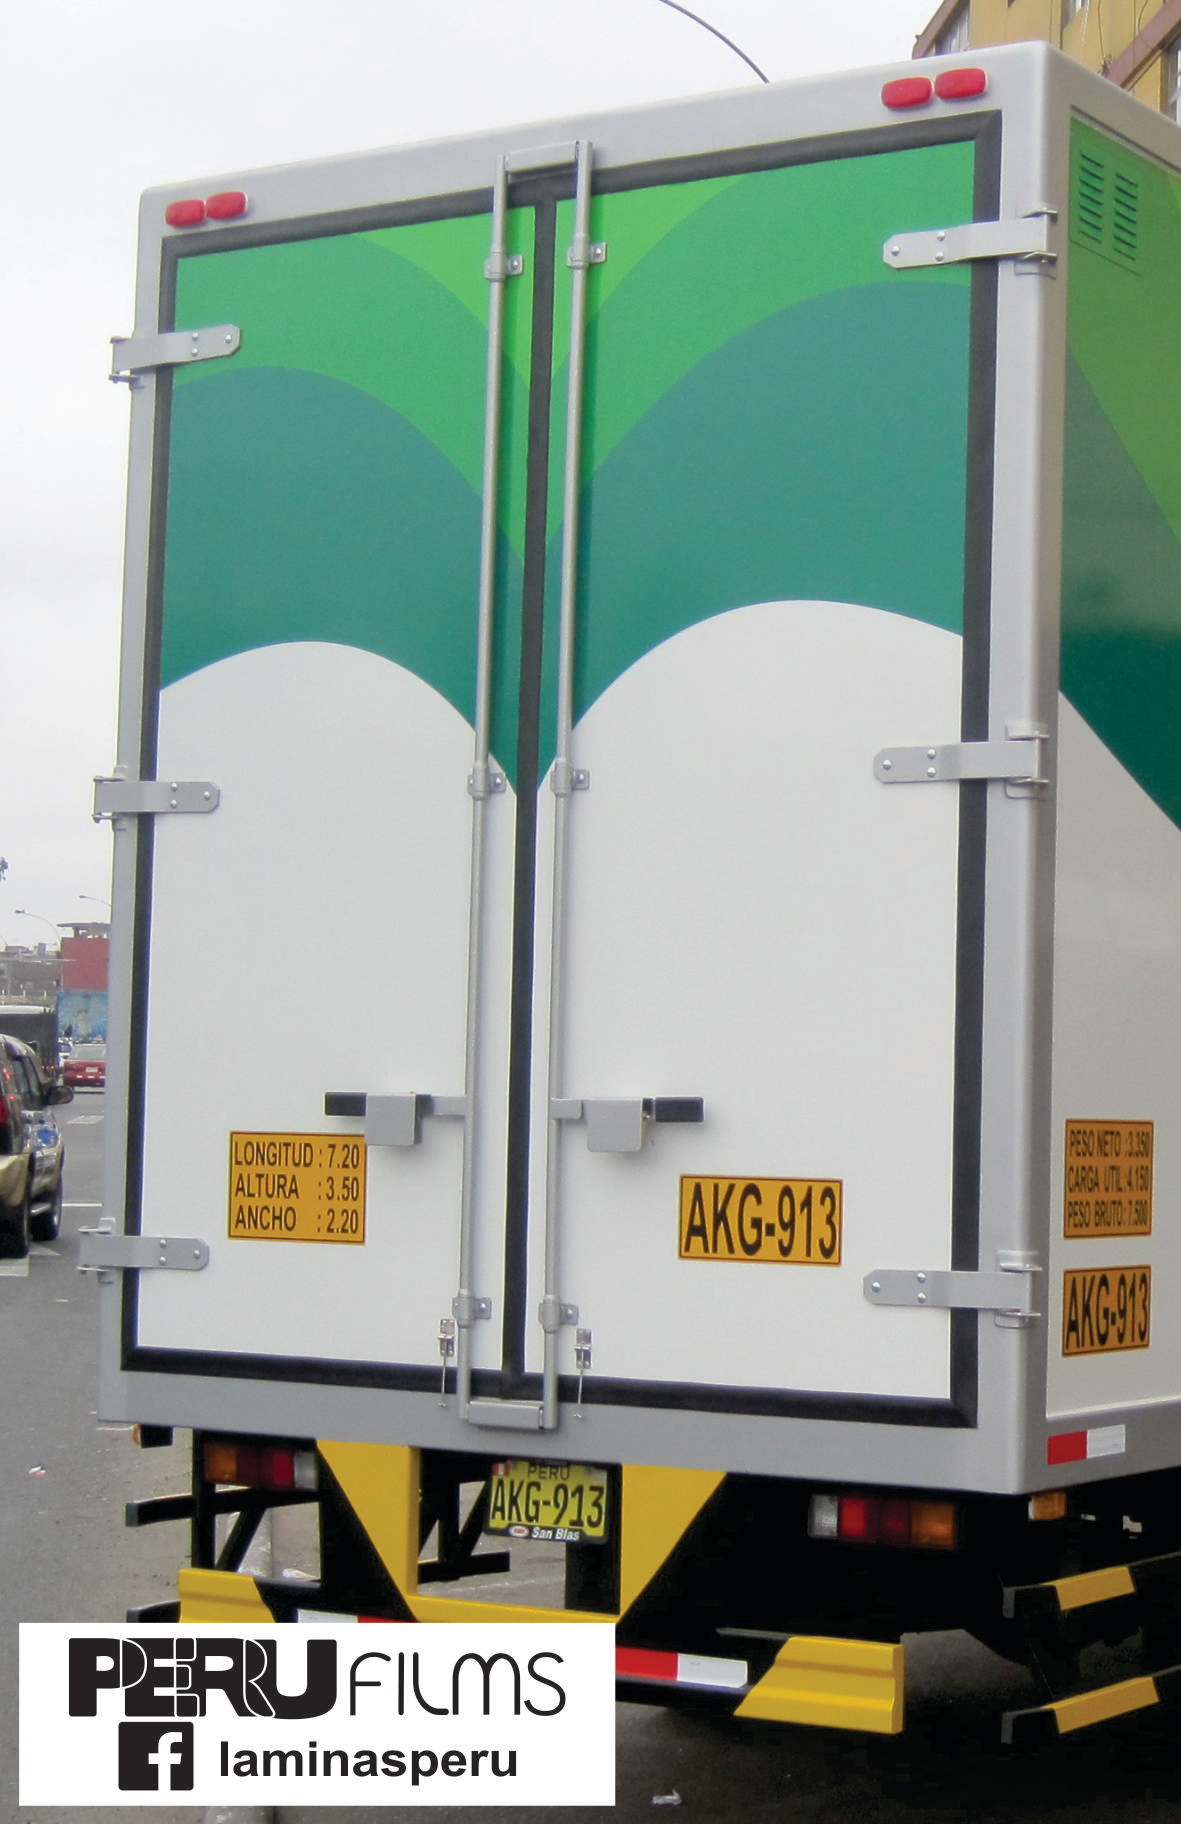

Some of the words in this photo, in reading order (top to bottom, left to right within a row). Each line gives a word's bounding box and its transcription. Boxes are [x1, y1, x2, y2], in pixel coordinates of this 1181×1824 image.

[234, 1141, 314, 1168] LONGITUD
[1069, 1130, 1095, 1157] PESO
[1097, 1130, 1121, 1157] NETO
[234, 1173, 300, 1200] ALTURA
[1067, 1165, 1099, 1193] CARGA
[1104, 1165, 1123, 1192] UTIL
[234, 1205, 297, 1232] ANCHO
[684, 1182, 838, 1259] AKG-913
[1067, 1200, 1091, 1227] PESO
[1065, 1272, 1149, 1349] AKG-913
[528, 1464, 571, 1481] PERU
[491, 1478, 604, 1529] AKG-913
[531, 1527, 553, 1540] San
[555, 1528, 580, 1541] Blas
